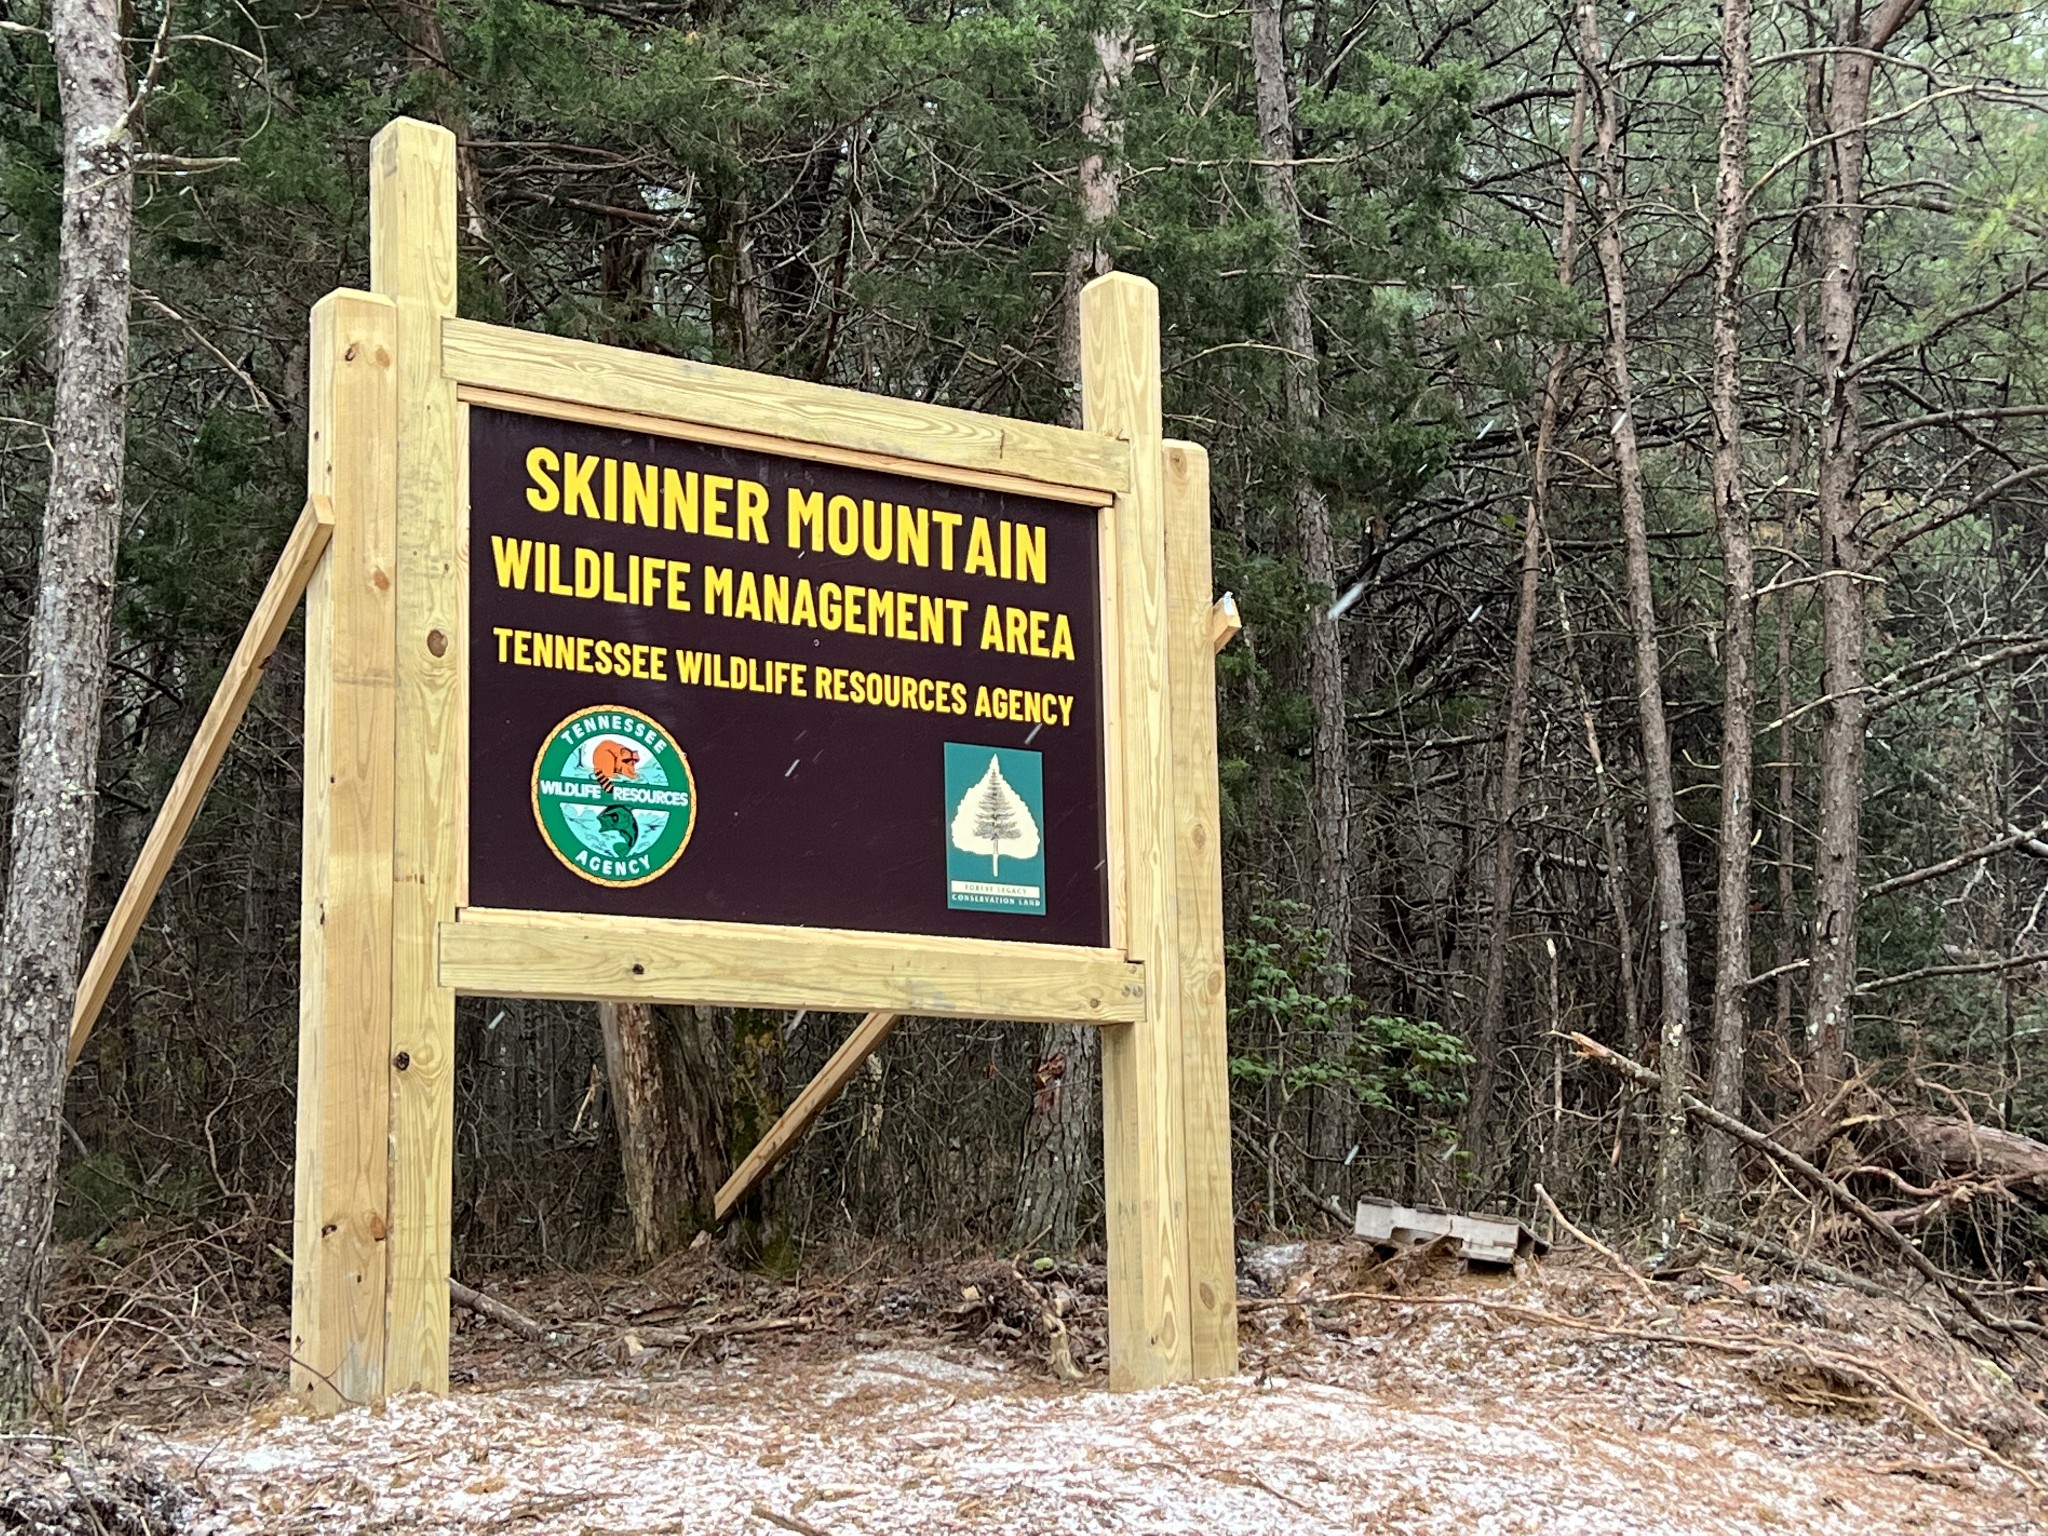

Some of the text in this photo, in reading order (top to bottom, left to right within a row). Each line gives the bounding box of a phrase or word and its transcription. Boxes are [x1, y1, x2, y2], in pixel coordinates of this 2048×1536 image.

[526, 446, 1046, 585] SKINNER MOUNTAIN
[491, 536, 1074, 661] WILDLIFE MANAGEMENT AREA
[493, 626, 1074, 726] TENNESSEE WILDLIFE RESOURCES AGENCY
[560, 714, 667, 754] TENNESSEE
[540, 779, 689, 807] WILDLIFE RESOURCES
[575, 850, 651, 876] AGENCY
[951, 893, 1041, 907] CONSERVATION LAND
[997, 886, 1027, 895] LEGACY
